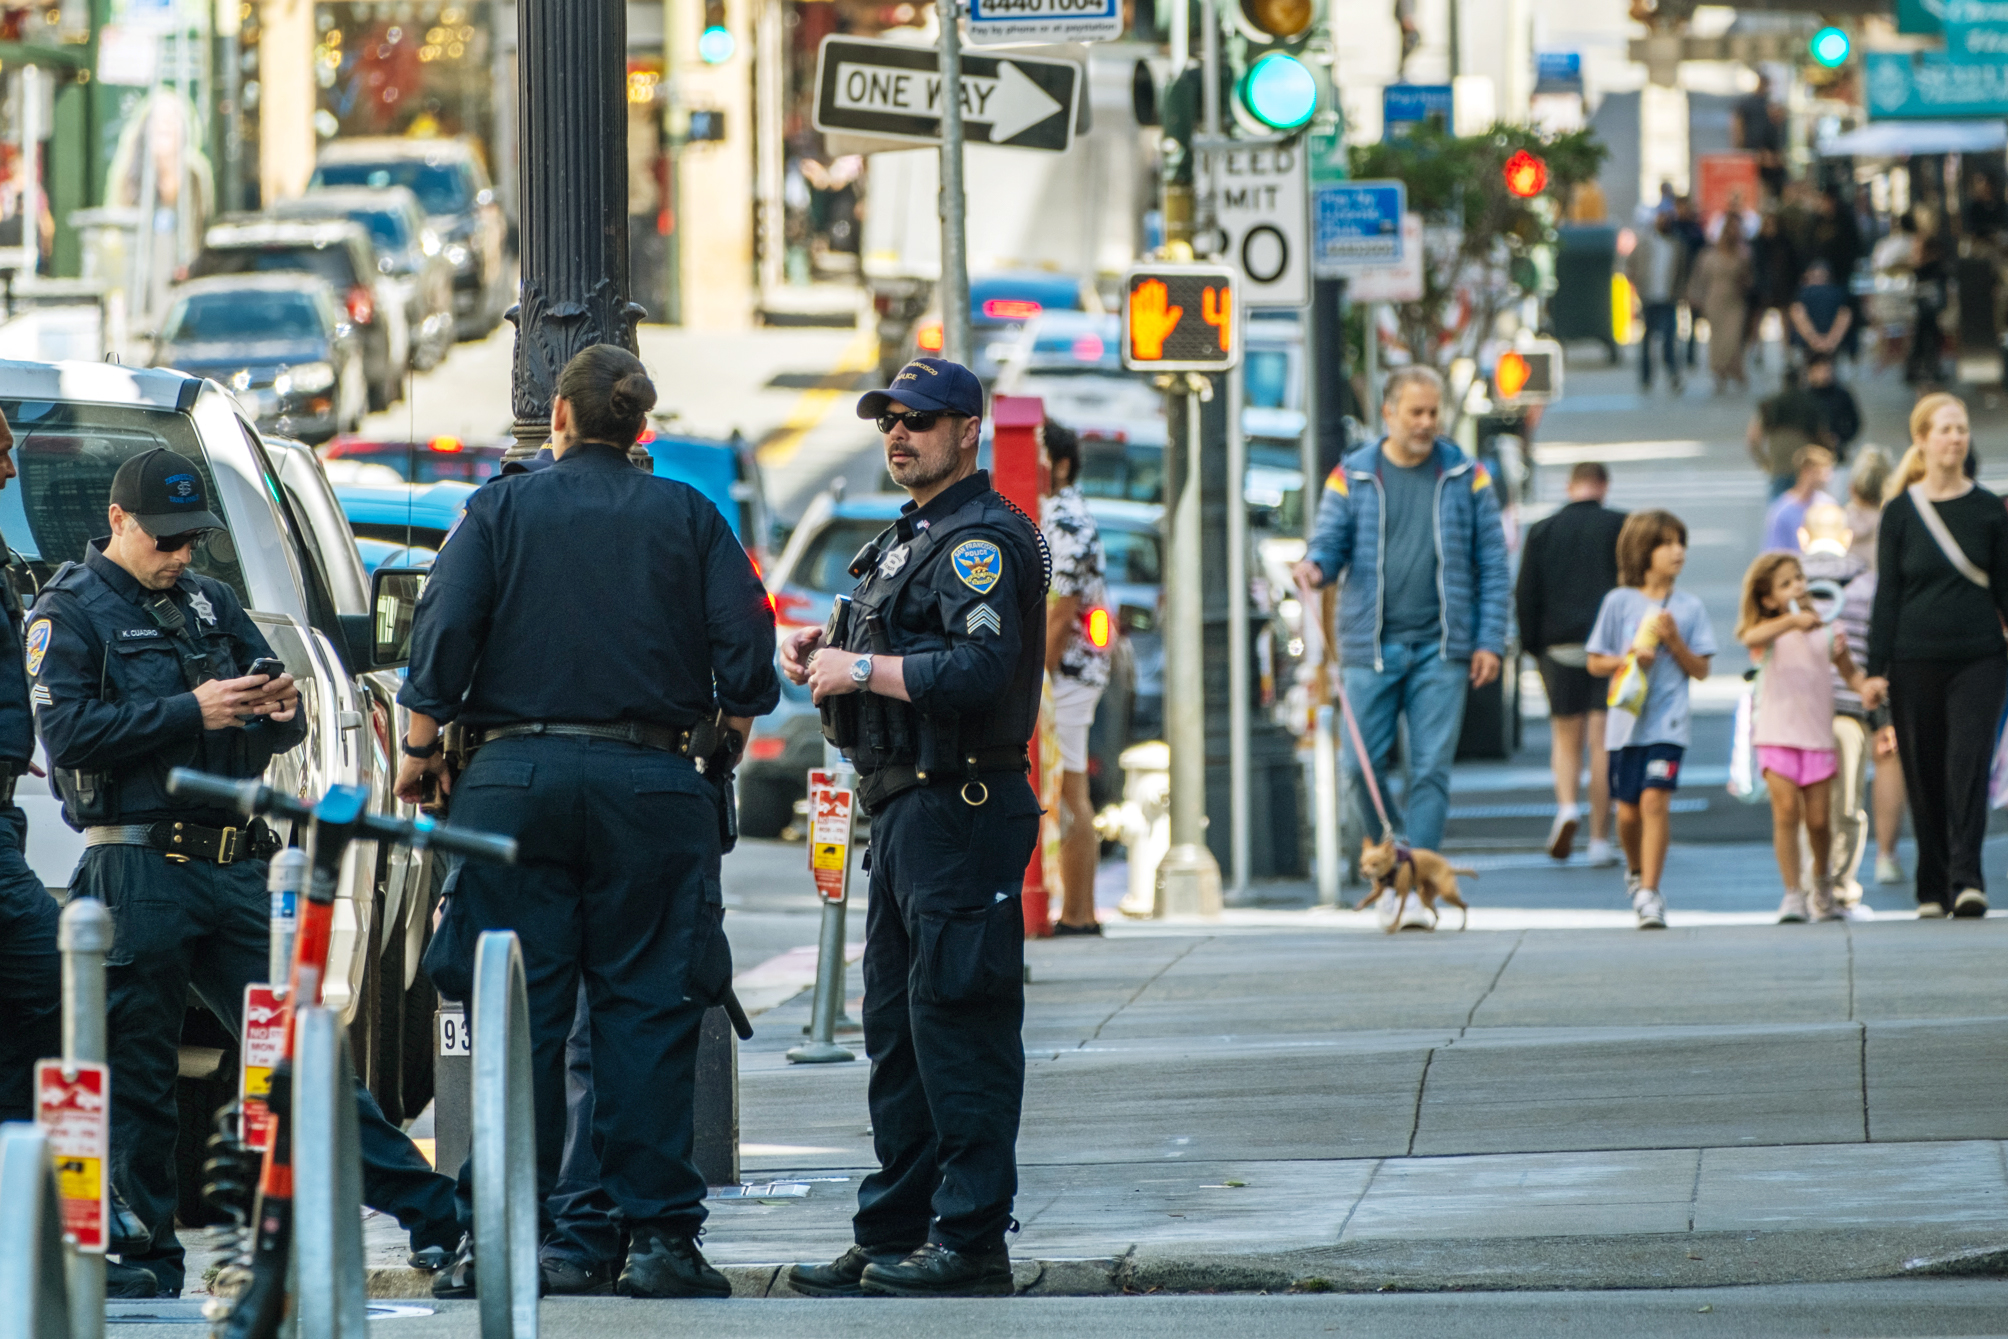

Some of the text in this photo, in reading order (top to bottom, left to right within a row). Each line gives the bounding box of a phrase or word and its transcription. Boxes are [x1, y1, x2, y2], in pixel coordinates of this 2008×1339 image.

[847, 71, 912, 108] ONE
[1224, 184, 1277, 209] MIT
[1202, 286, 1231, 352] 4
[954, 542, 997, 558] SAN FRANCISCO
[965, 549, 988, 558] POLICE
[131, 629, 158, 637] CUADRO
[250, 1028, 269, 1039] NO
[444, 1019, 471, 1051] 93
[251, 1043, 275, 1052] MON
